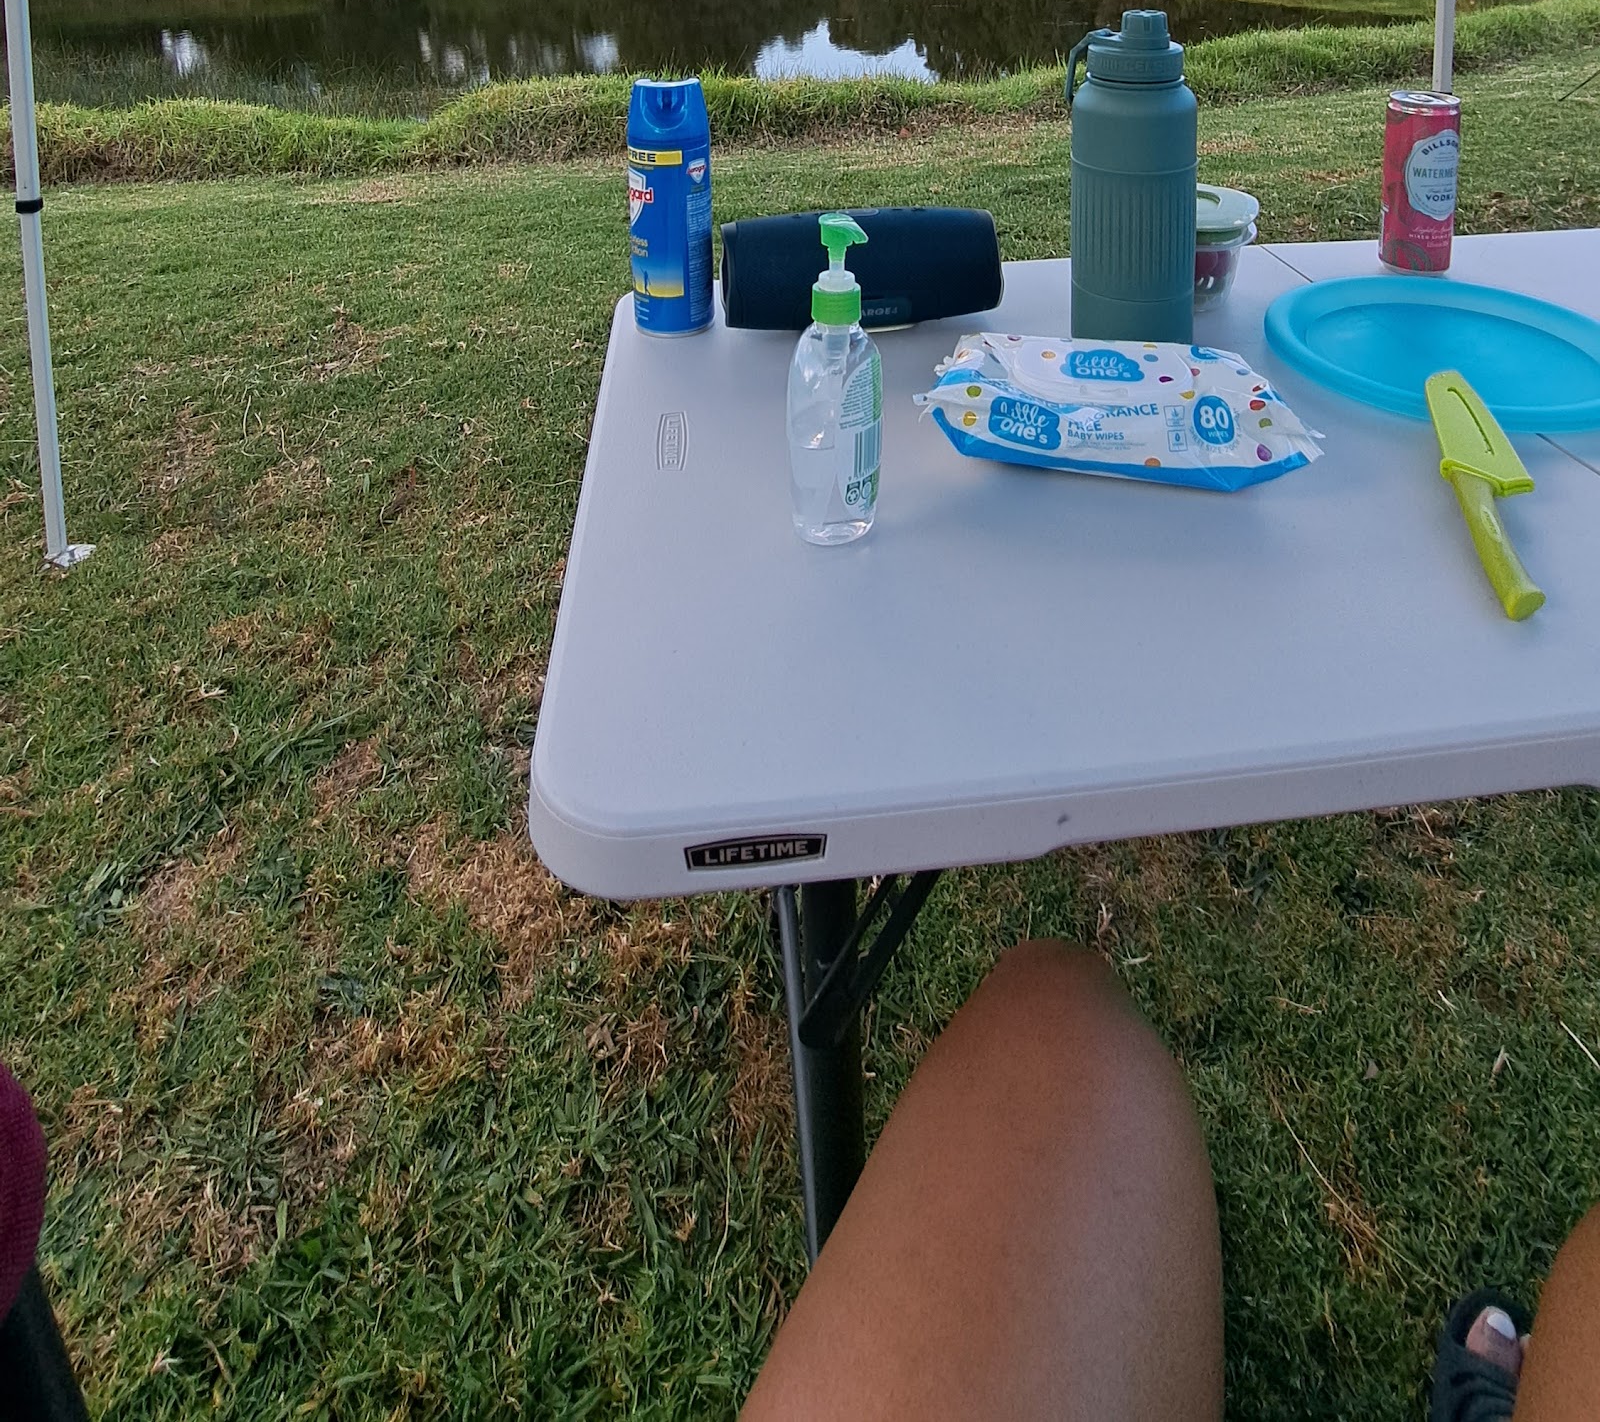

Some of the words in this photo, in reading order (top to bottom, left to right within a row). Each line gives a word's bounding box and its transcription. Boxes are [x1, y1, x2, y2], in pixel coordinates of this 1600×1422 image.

[1199, 404, 1229, 429] 80
[1067, 429, 1092, 441] BABY
[1095, 431, 1124, 441] WIPES
[704, 840, 809, 865] LIFETIME
